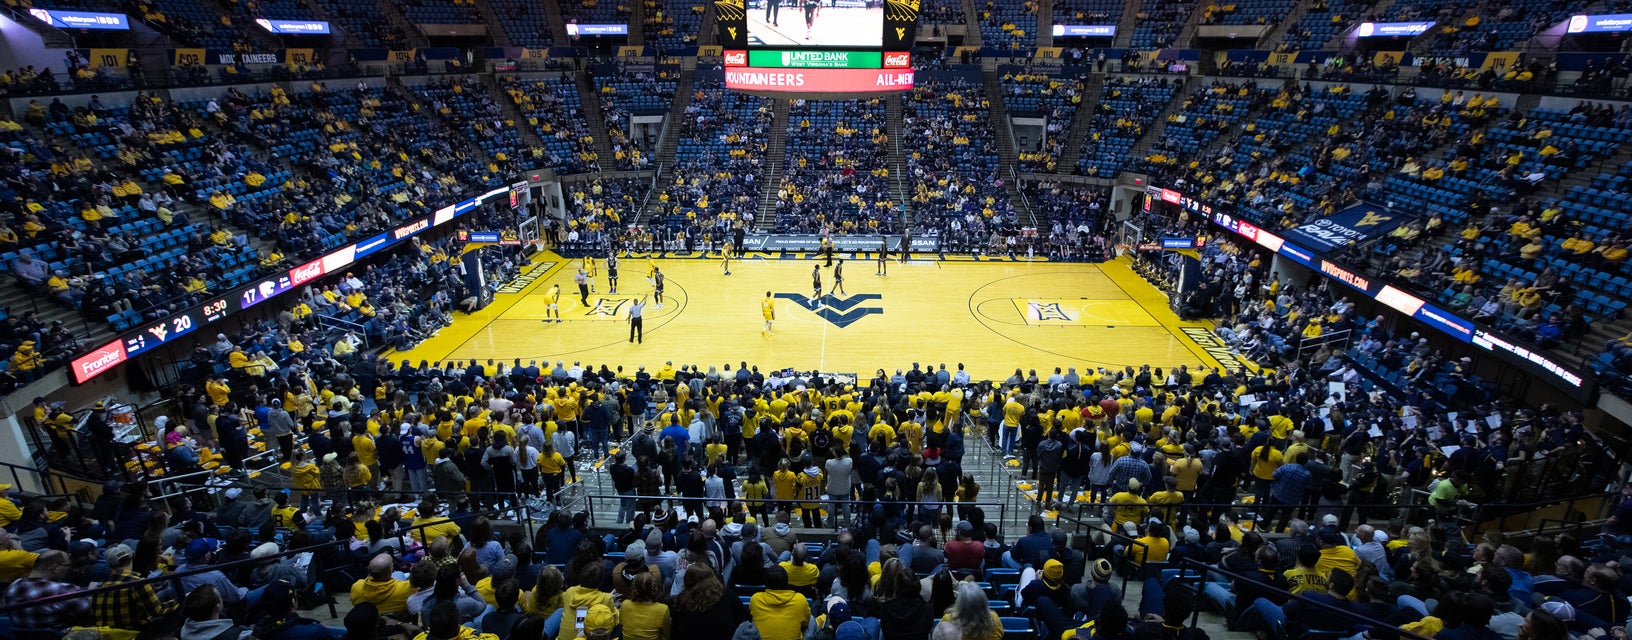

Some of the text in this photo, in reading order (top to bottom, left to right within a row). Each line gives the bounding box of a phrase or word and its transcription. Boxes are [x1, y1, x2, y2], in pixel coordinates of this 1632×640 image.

[528, 50, 543, 58] 105
[725, 53, 745, 65] Coca-Cola
[790, 52, 848, 61] UNITED BANK
[885, 54, 908, 66] Coca-Cola
[1276, 54, 1288, 63] 112
[101, 54, 119, 67] 101
[1492, 57, 1506, 69] 114
[243, 288, 256, 303] 17
[203, 300, 227, 316] 8:30
[173, 315, 191, 332] 20
[82, 349, 119, 374] Frontier
